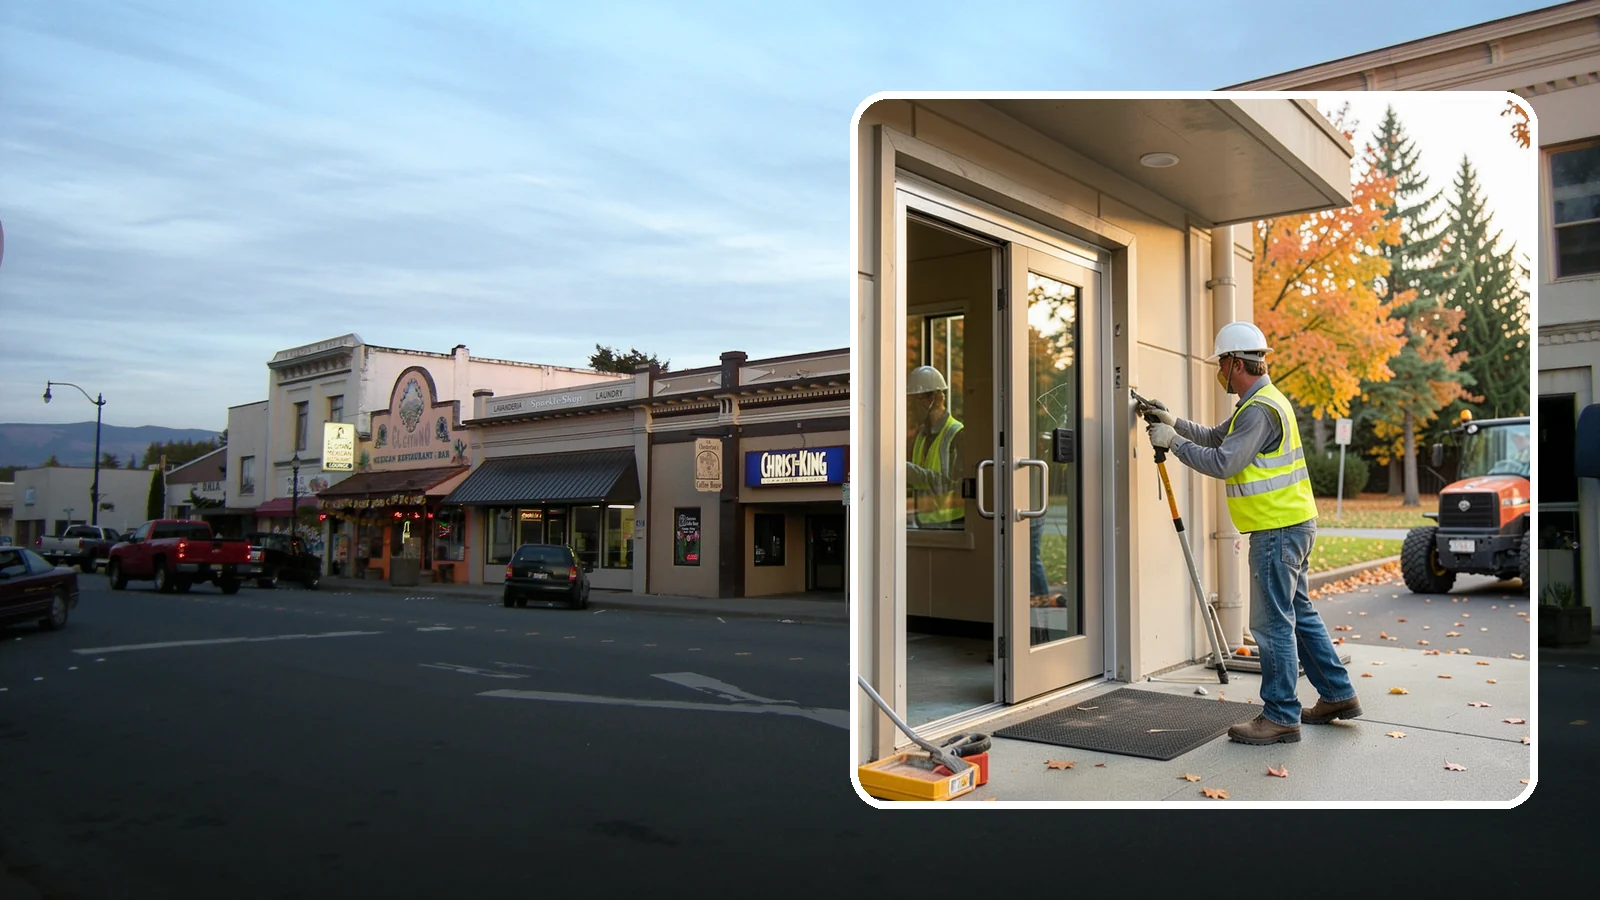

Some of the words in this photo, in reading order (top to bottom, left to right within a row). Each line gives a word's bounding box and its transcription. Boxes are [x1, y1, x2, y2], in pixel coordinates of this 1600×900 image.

[562, 395, 583, 405] Shop
[595, 389, 623, 400] LAUNDRY
[493, 402, 522, 413] LAVANDERIA
[374, 455, 396, 464] MEXICAN
[398, 452, 433, 462] RESTAURANT
[438, 450, 450, 459] BAR
[760, 452, 797, 478] CHRIST
[799, 450, 828, 476] KING
